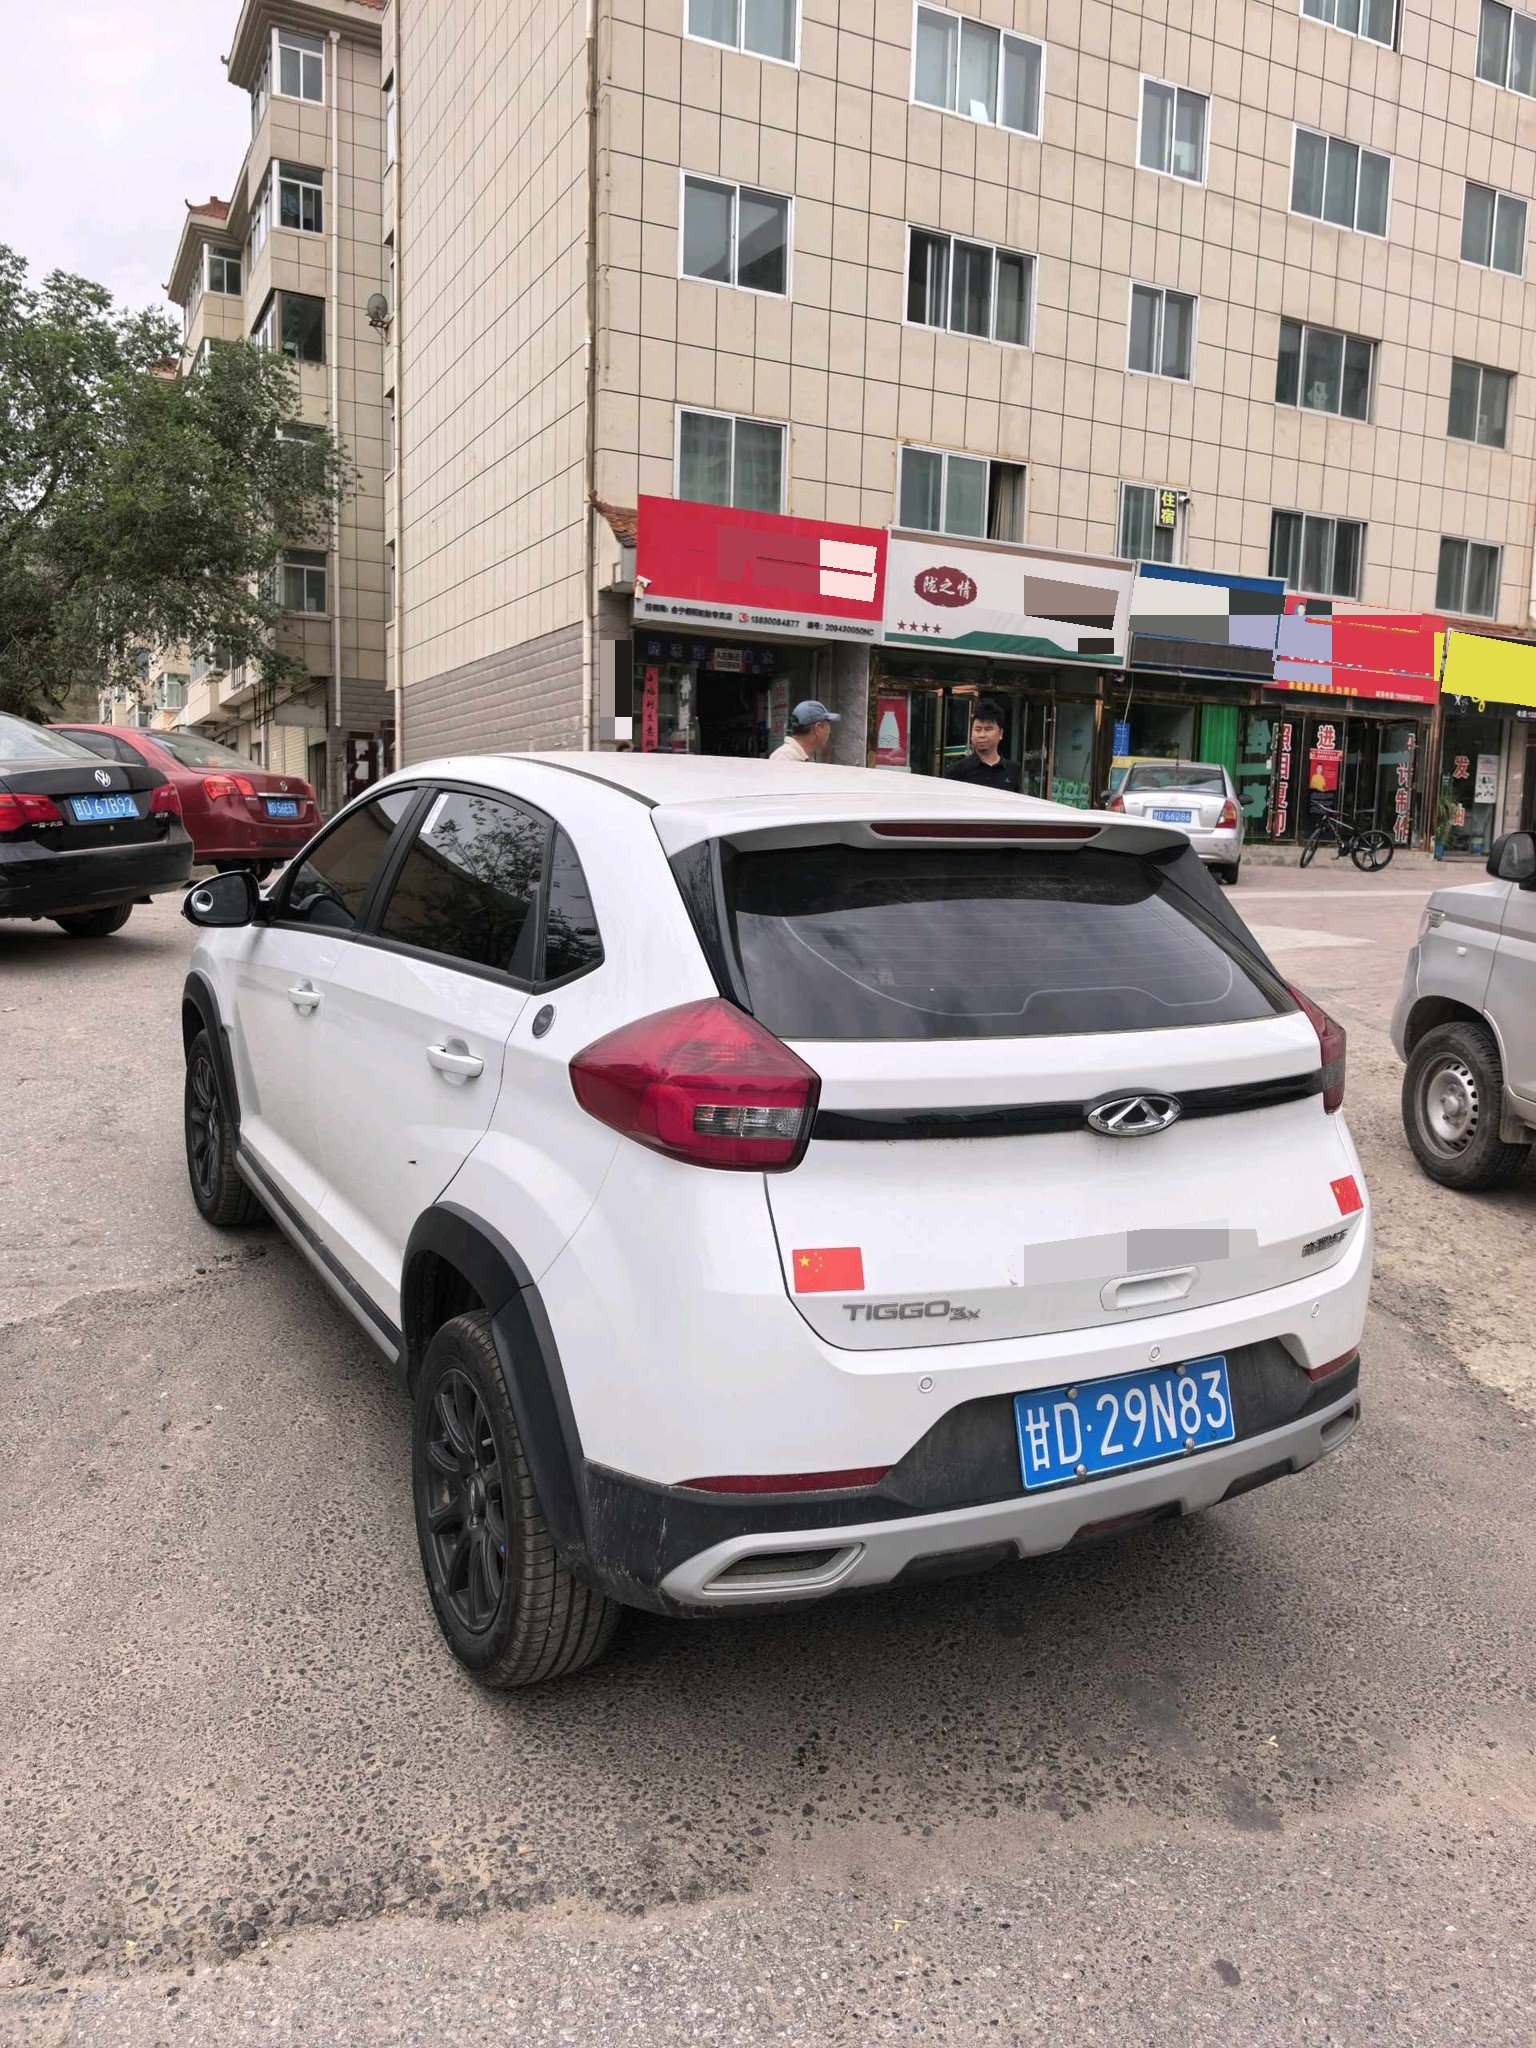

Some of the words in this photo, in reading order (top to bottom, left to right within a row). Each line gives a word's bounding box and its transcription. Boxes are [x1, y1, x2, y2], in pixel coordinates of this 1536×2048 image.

[1161, 490, 1175, 525] 住宿
[922, 575, 972, 600] 陇之情
[1453, 755, 1470, 779] 发
